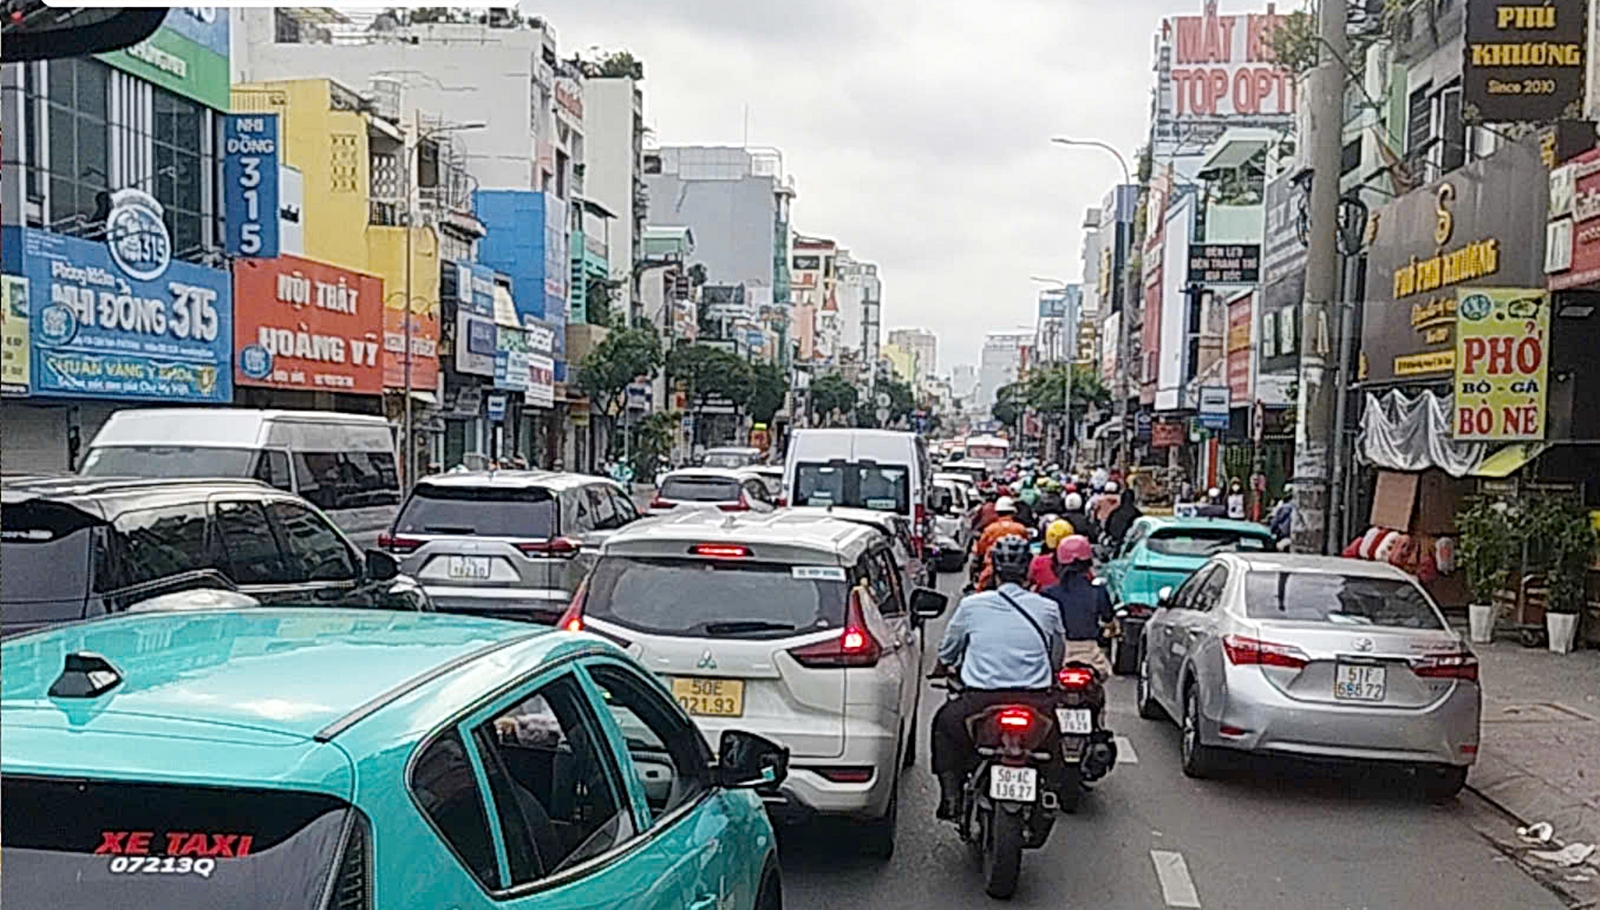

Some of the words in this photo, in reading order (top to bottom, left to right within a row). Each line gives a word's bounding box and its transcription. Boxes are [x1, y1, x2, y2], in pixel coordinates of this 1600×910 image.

[1177, 0, 1236, 64] MẮT
[1171, 68, 1228, 115] TOP
[1488, 79, 1521, 93] Since
[1523, 80, 1555, 93] 2010
[235, 118, 264, 134] NHI
[277, 270, 311, 312] NỘI
[51, 283, 94, 327] NHI
[167, 281, 219, 343] 315
[256, 322, 347, 365] HOÀNG
[1461, 320, 1543, 376] PHỞ
[1462, 379, 1492, 395] BÒ
[1459, 397, 1494, 437] BÒ
[1502, 397, 1539, 436] NÉ
[691, 679, 722, 696] 50E
[94, 832, 154, 855] XE
[167, 832, 252, 858] TAXI
[110, 856, 216, 878] 07213Q
